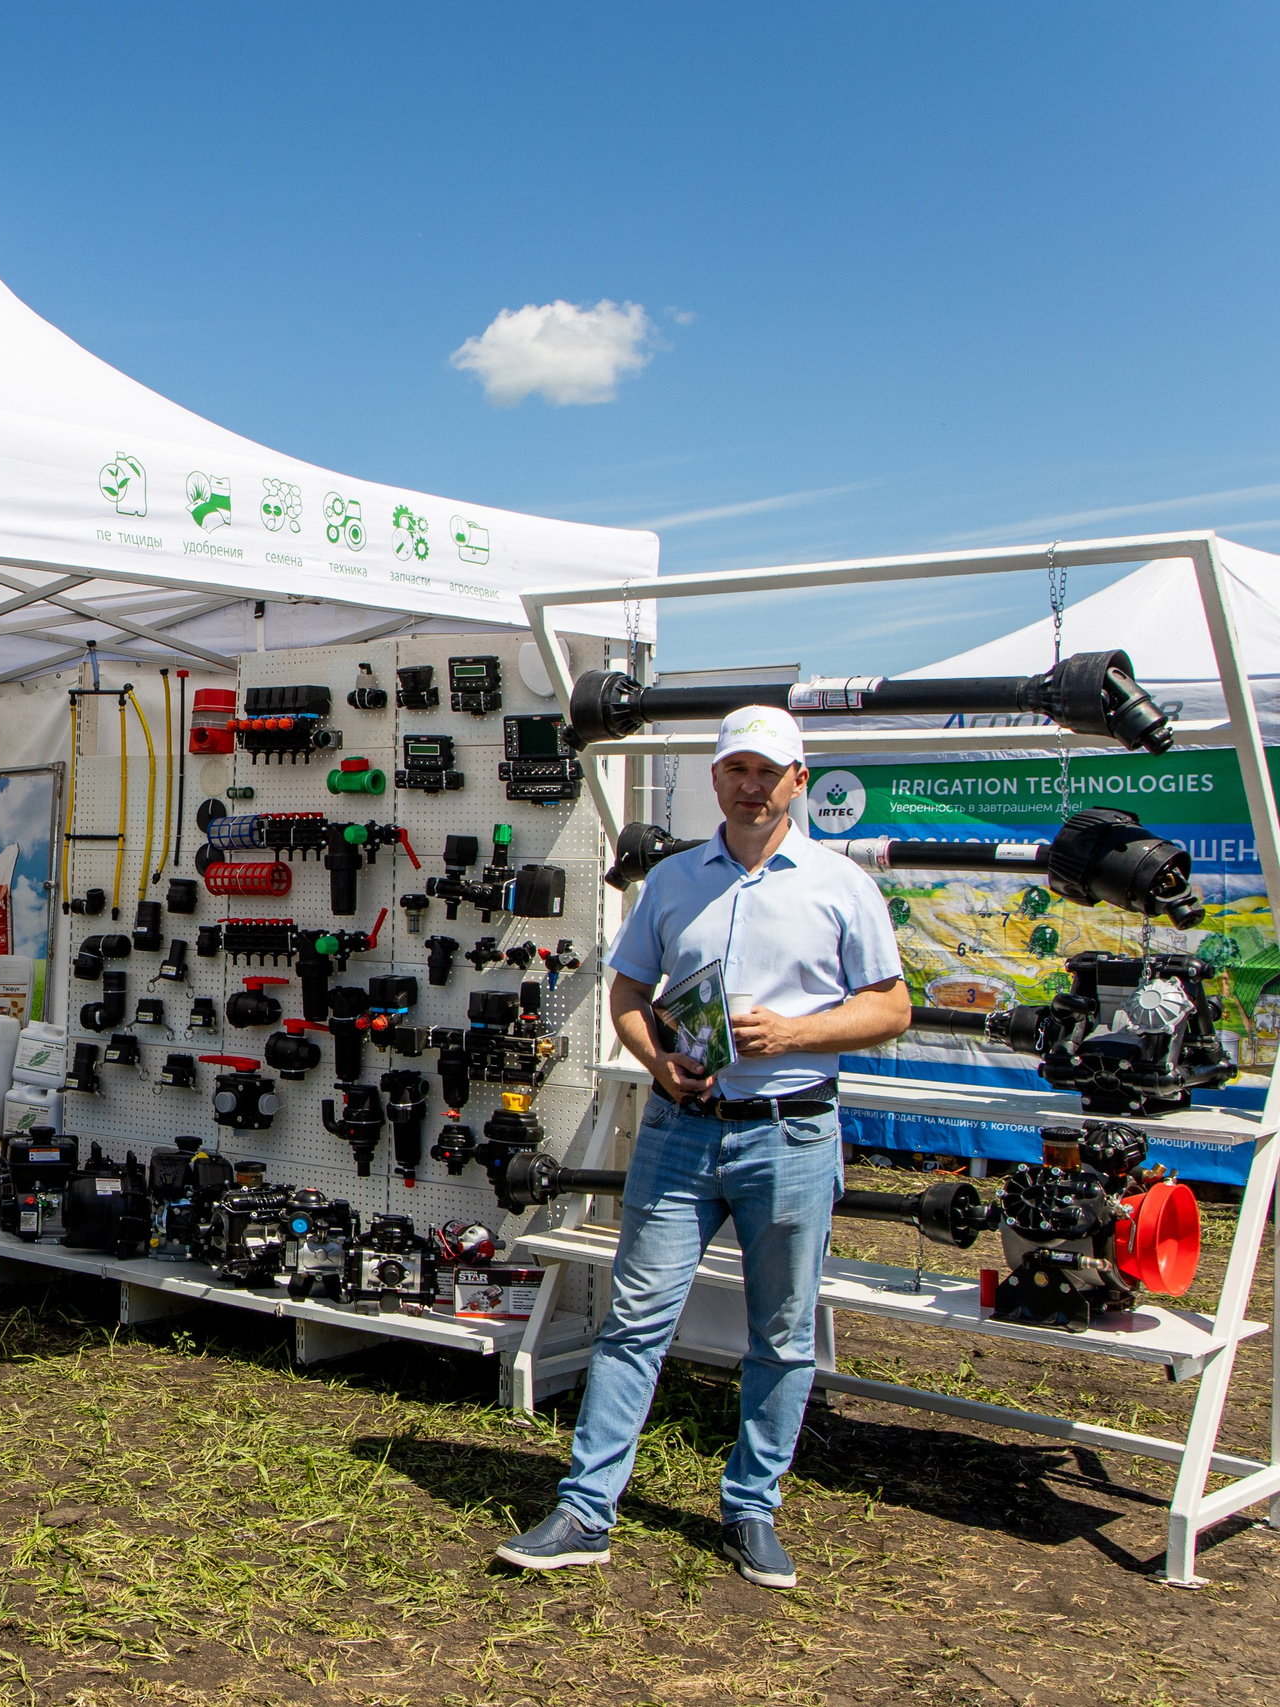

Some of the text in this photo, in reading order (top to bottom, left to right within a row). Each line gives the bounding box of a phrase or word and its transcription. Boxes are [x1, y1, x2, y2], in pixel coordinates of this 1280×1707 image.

[182, 537, 244, 561] удобрения
[265, 550, 304, 569] семена
[328, 560, 368, 579] техника
[389, 569, 431, 588] запчасти
[449, 580, 500, 601] агросервис
[891, 774, 1214, 796] IRRIGATION TECHNOLOGIES
[818, 807, 854, 817] IRTEC
[889, 801, 966, 815] Уверенность
[968, 803, 975, 812] в
[978, 802, 1052, 814] завтрашнем
[1001, 912, 1011, 928] 7
[957, 942, 966, 957] 6
[966, 988, 976, 1003] 3
[850, 1109, 879, 1119] (РЕЧКИ)
[888, 1112, 922, 1123] ПОДАЕТ
[924, 1116, 936, 1124] НА
[938, 1117, 978, 1129] МАШИНУ
[981, 1121, 989, 1130] 9,
[991, 1122, 1035, 1134] КОТОРАЯ
[1148, 1136, 1235, 1153] ОМОЩИ ПУШКИ.
[458, 1273, 488, 1281] STAR
